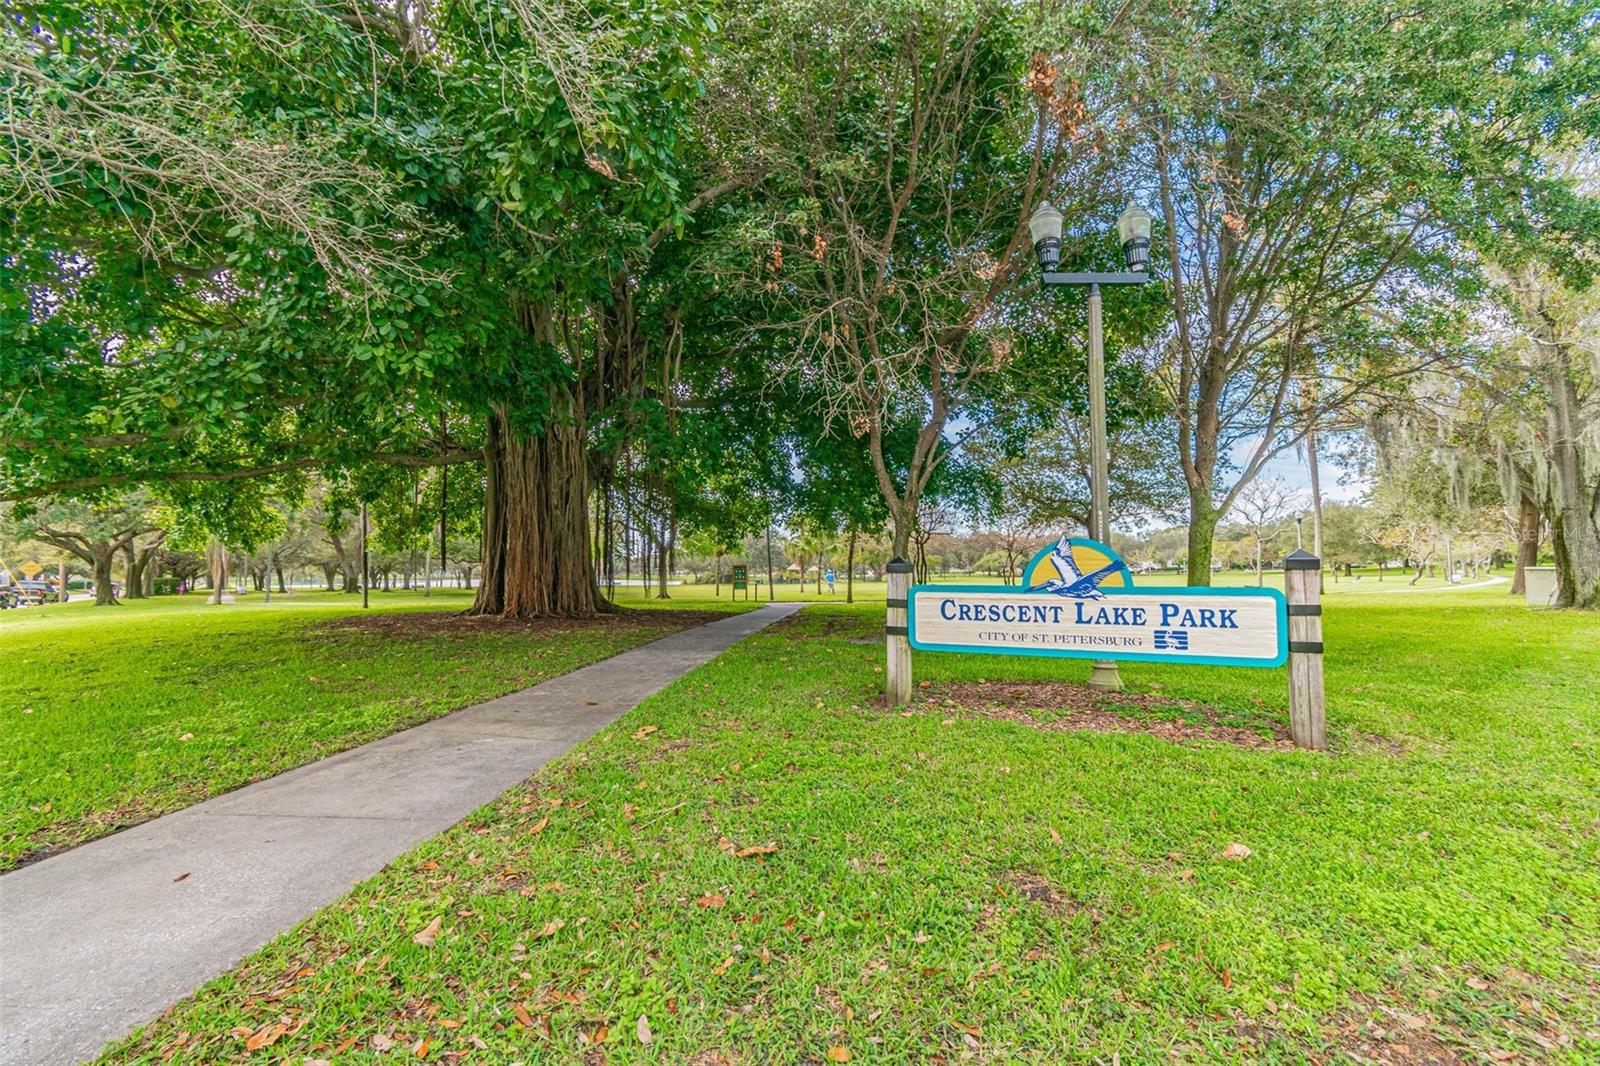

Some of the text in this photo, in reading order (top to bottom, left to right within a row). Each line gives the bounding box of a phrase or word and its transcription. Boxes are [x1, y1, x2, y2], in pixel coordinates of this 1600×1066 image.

[940, 598, 1239, 629] CRESCENT LAKE PARK
[978, 631, 1143, 647] CITY OF ST. PETERSBURG
